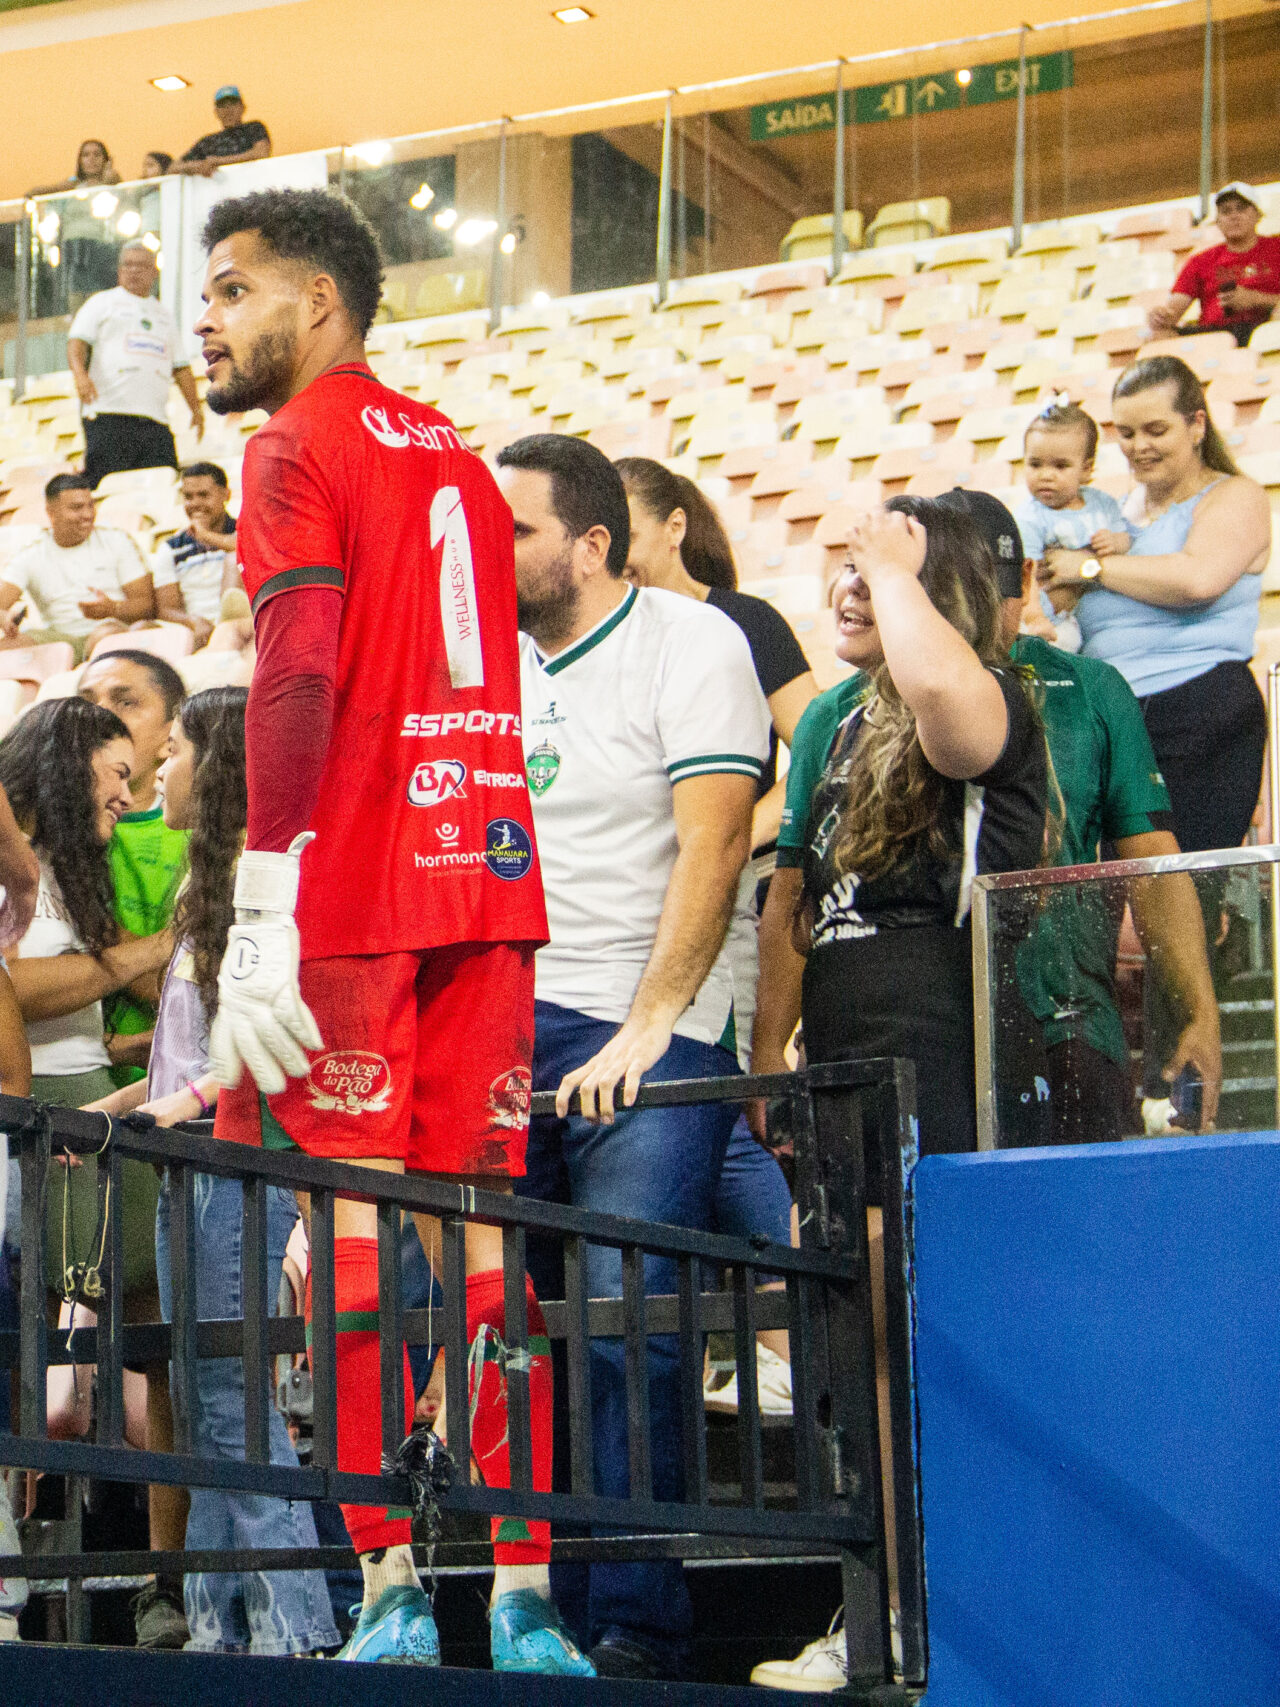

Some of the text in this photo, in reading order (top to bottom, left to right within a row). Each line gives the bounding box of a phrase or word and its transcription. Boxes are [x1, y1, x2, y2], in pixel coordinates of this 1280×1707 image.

[765, 102, 834, 134] SAÍDA
[398, 412, 476, 456] Sam
[429, 485, 485, 689] 1
[451, 563, 472, 641] WELLNESS
[496, 856, 522, 864] SPORTS
[323, 1059, 383, 1079] Bodega
[335, 1076, 372, 1095] Pão
